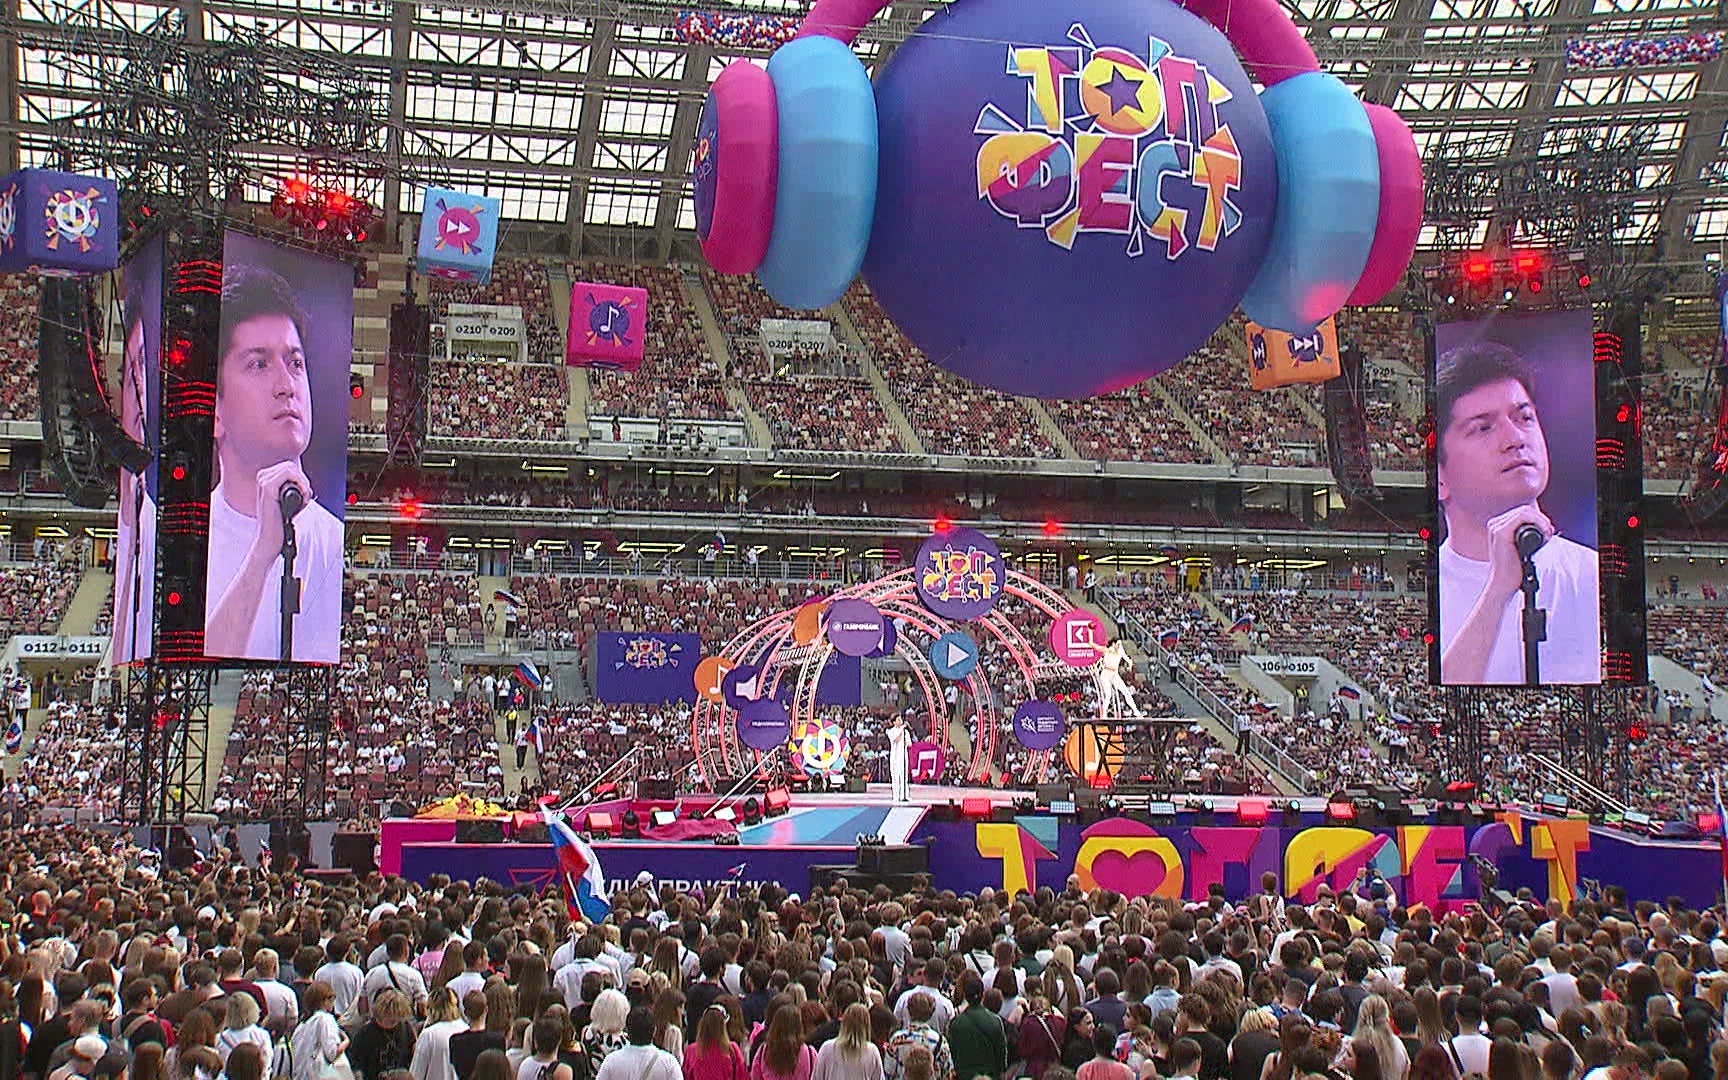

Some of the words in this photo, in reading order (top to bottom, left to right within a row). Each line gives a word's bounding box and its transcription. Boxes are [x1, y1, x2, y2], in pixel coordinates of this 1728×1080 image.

[1006, 44, 1222, 148] ТОП
[976, 130, 1242, 252] ФЕСТ
[463, 325, 482, 335] 210
[497, 326, 516, 336] 209
[929, 550, 987, 576] ТОП
[922, 572, 997, 600] ФЕСТ
[34, 642, 57, 653] 112
[79, 643, 101, 653] 111
[1262, 661, 1280, 671] 106
[1296, 662, 1315, 672] 105
